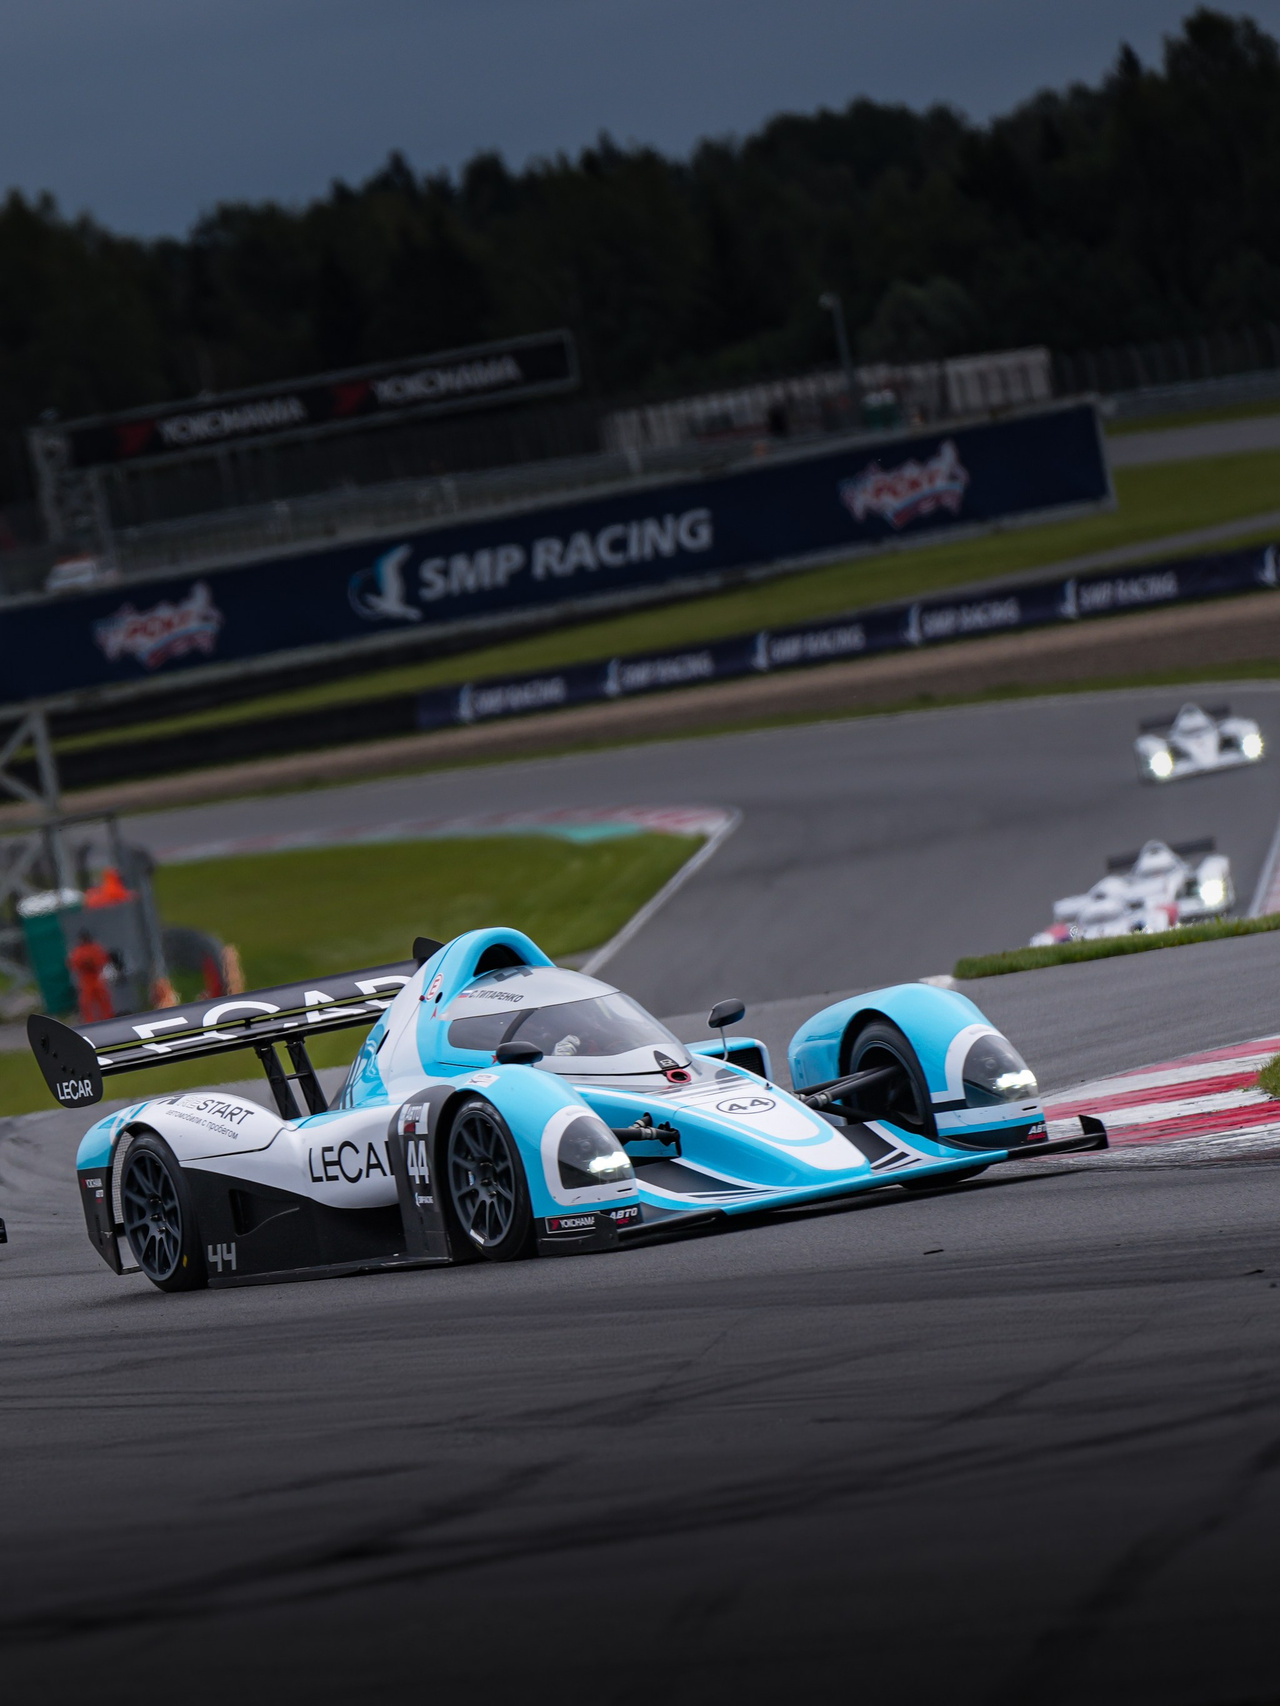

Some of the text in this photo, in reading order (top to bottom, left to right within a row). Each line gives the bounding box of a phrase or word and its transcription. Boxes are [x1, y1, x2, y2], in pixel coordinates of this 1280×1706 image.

[418, 507, 715, 602] SMP RACING
[57, 1079, 93, 1100] LECAR
[728, 1098, 770, 1112] 44
[407, 1140, 430, 1184] 44
[610, 1207, 638, 1219] АВТО
[207, 1242, 237, 1272] 44
